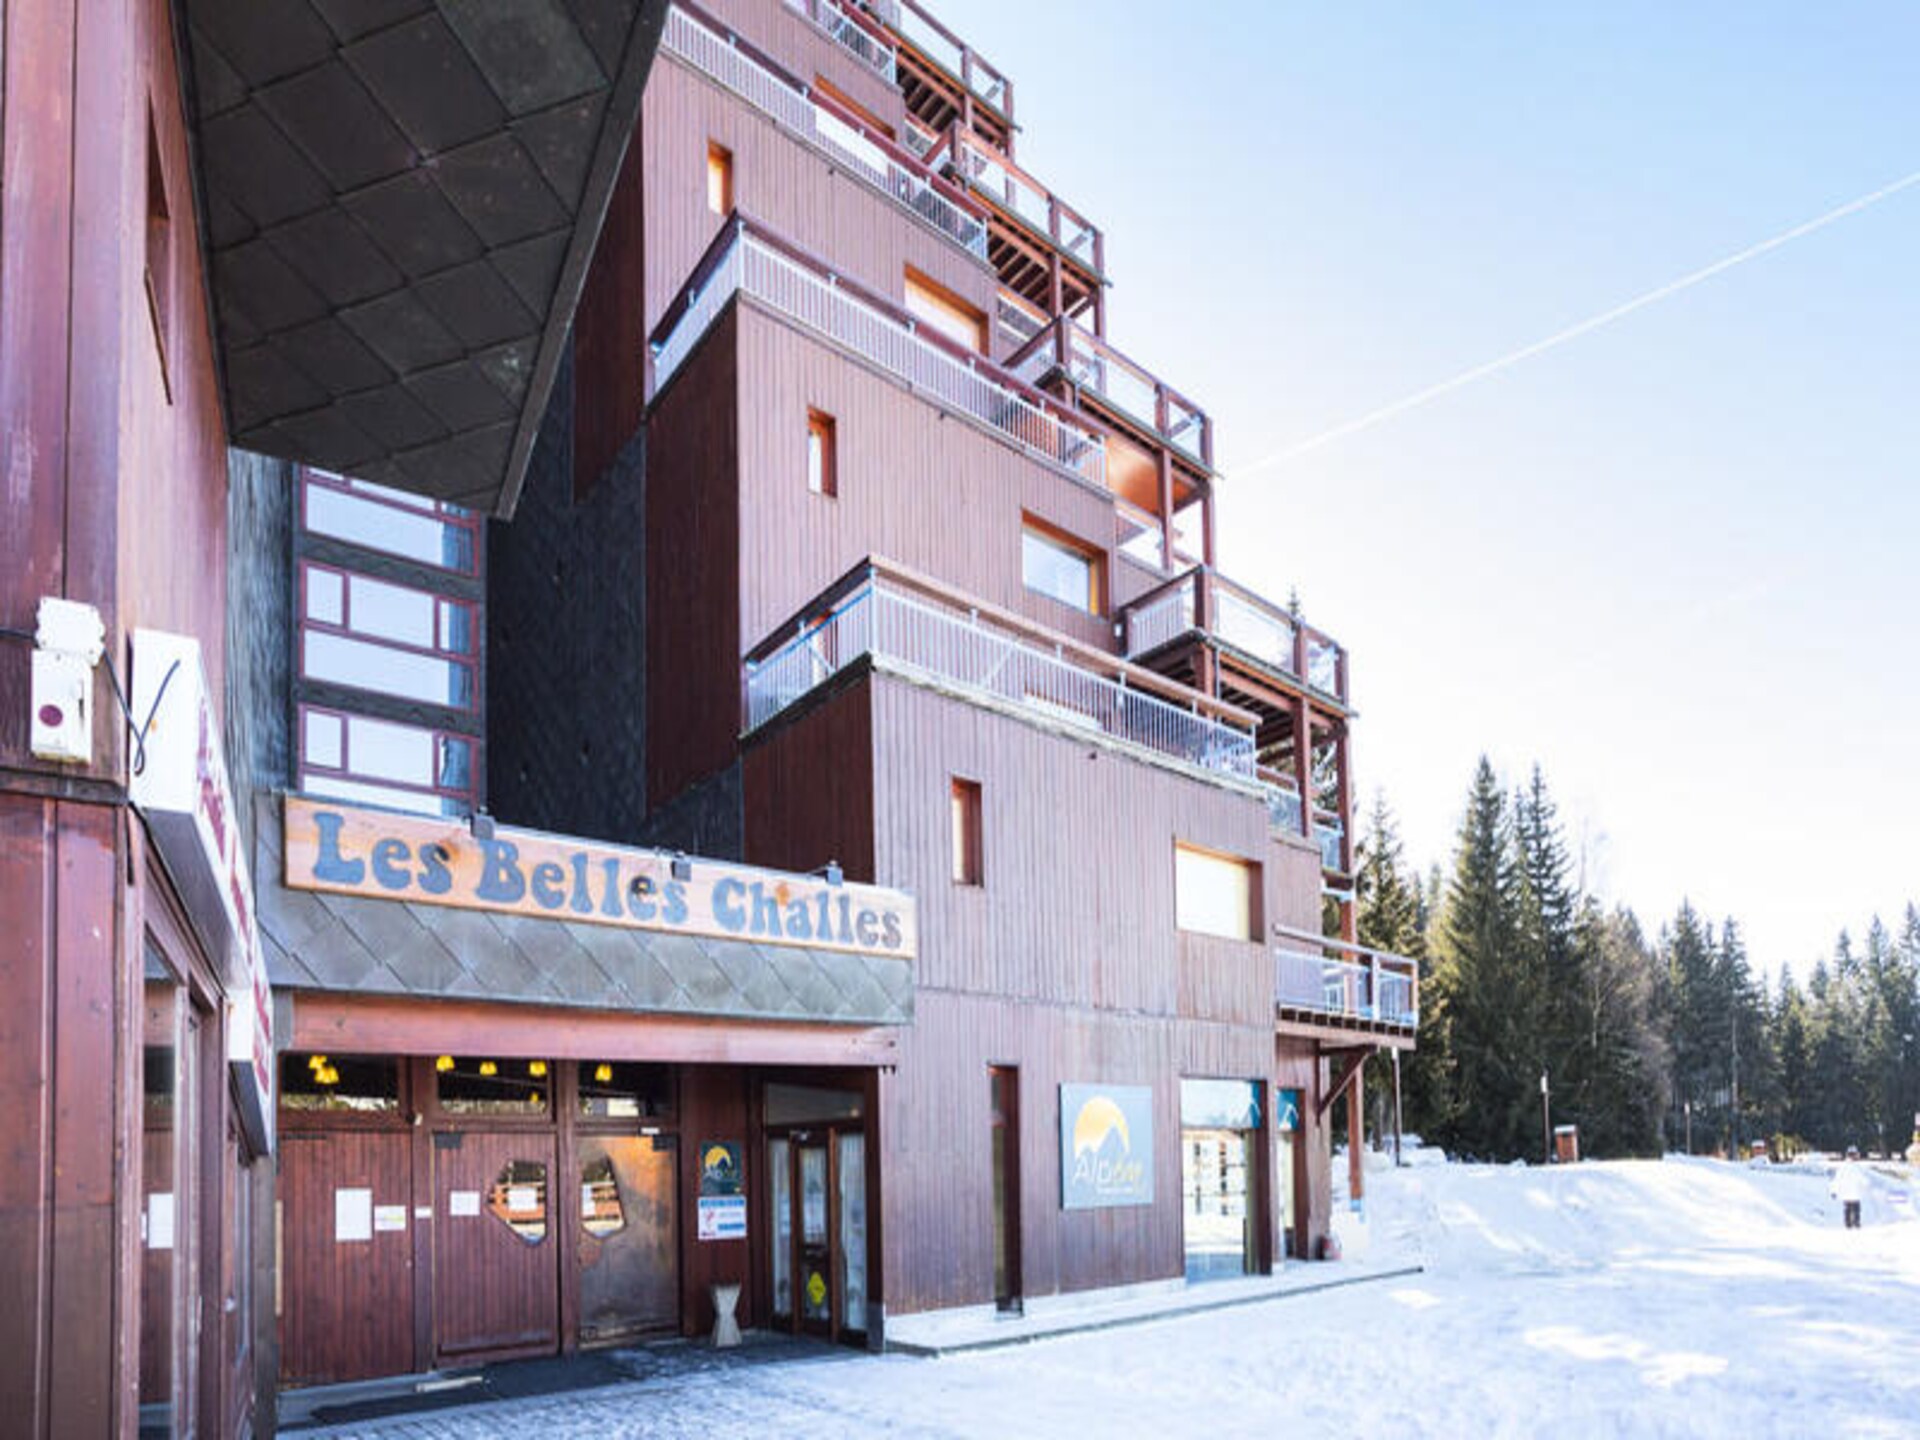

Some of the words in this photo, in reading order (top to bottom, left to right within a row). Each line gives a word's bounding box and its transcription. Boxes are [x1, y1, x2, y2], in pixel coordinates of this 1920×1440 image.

[312, 811, 454, 894] Les
[474, 839, 690, 922] Belles
[711, 876, 904, 948] Challes
